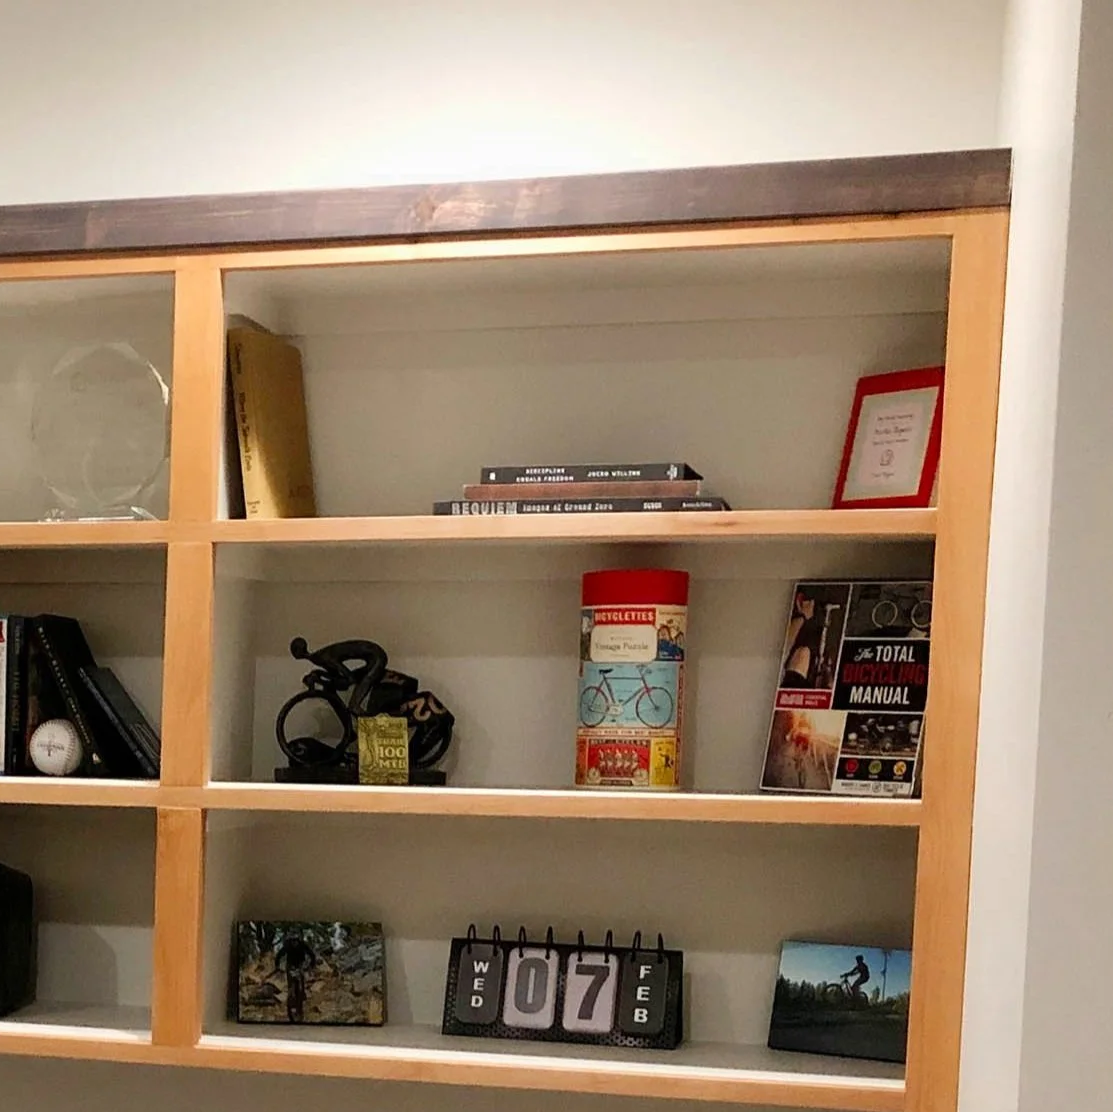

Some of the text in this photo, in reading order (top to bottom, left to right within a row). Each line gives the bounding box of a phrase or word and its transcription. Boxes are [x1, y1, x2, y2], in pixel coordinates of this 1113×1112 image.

[451, 501, 517, 515] REQUIEM
[522, 503, 550, 513] Images
[595, 502, 613, 511] Zero
[594, 611, 655, 622] BICYCLETTES
[854, 645, 916, 662] The TOTAL
[843, 663, 927, 685] BICYCLING
[849, 686, 910, 705] MANUAL
[379, 746, 406, 758] 100
[379, 760, 406, 769] MTB
[471, 960, 489, 1008] WED
[633, 965, 652, 1024] FEB
